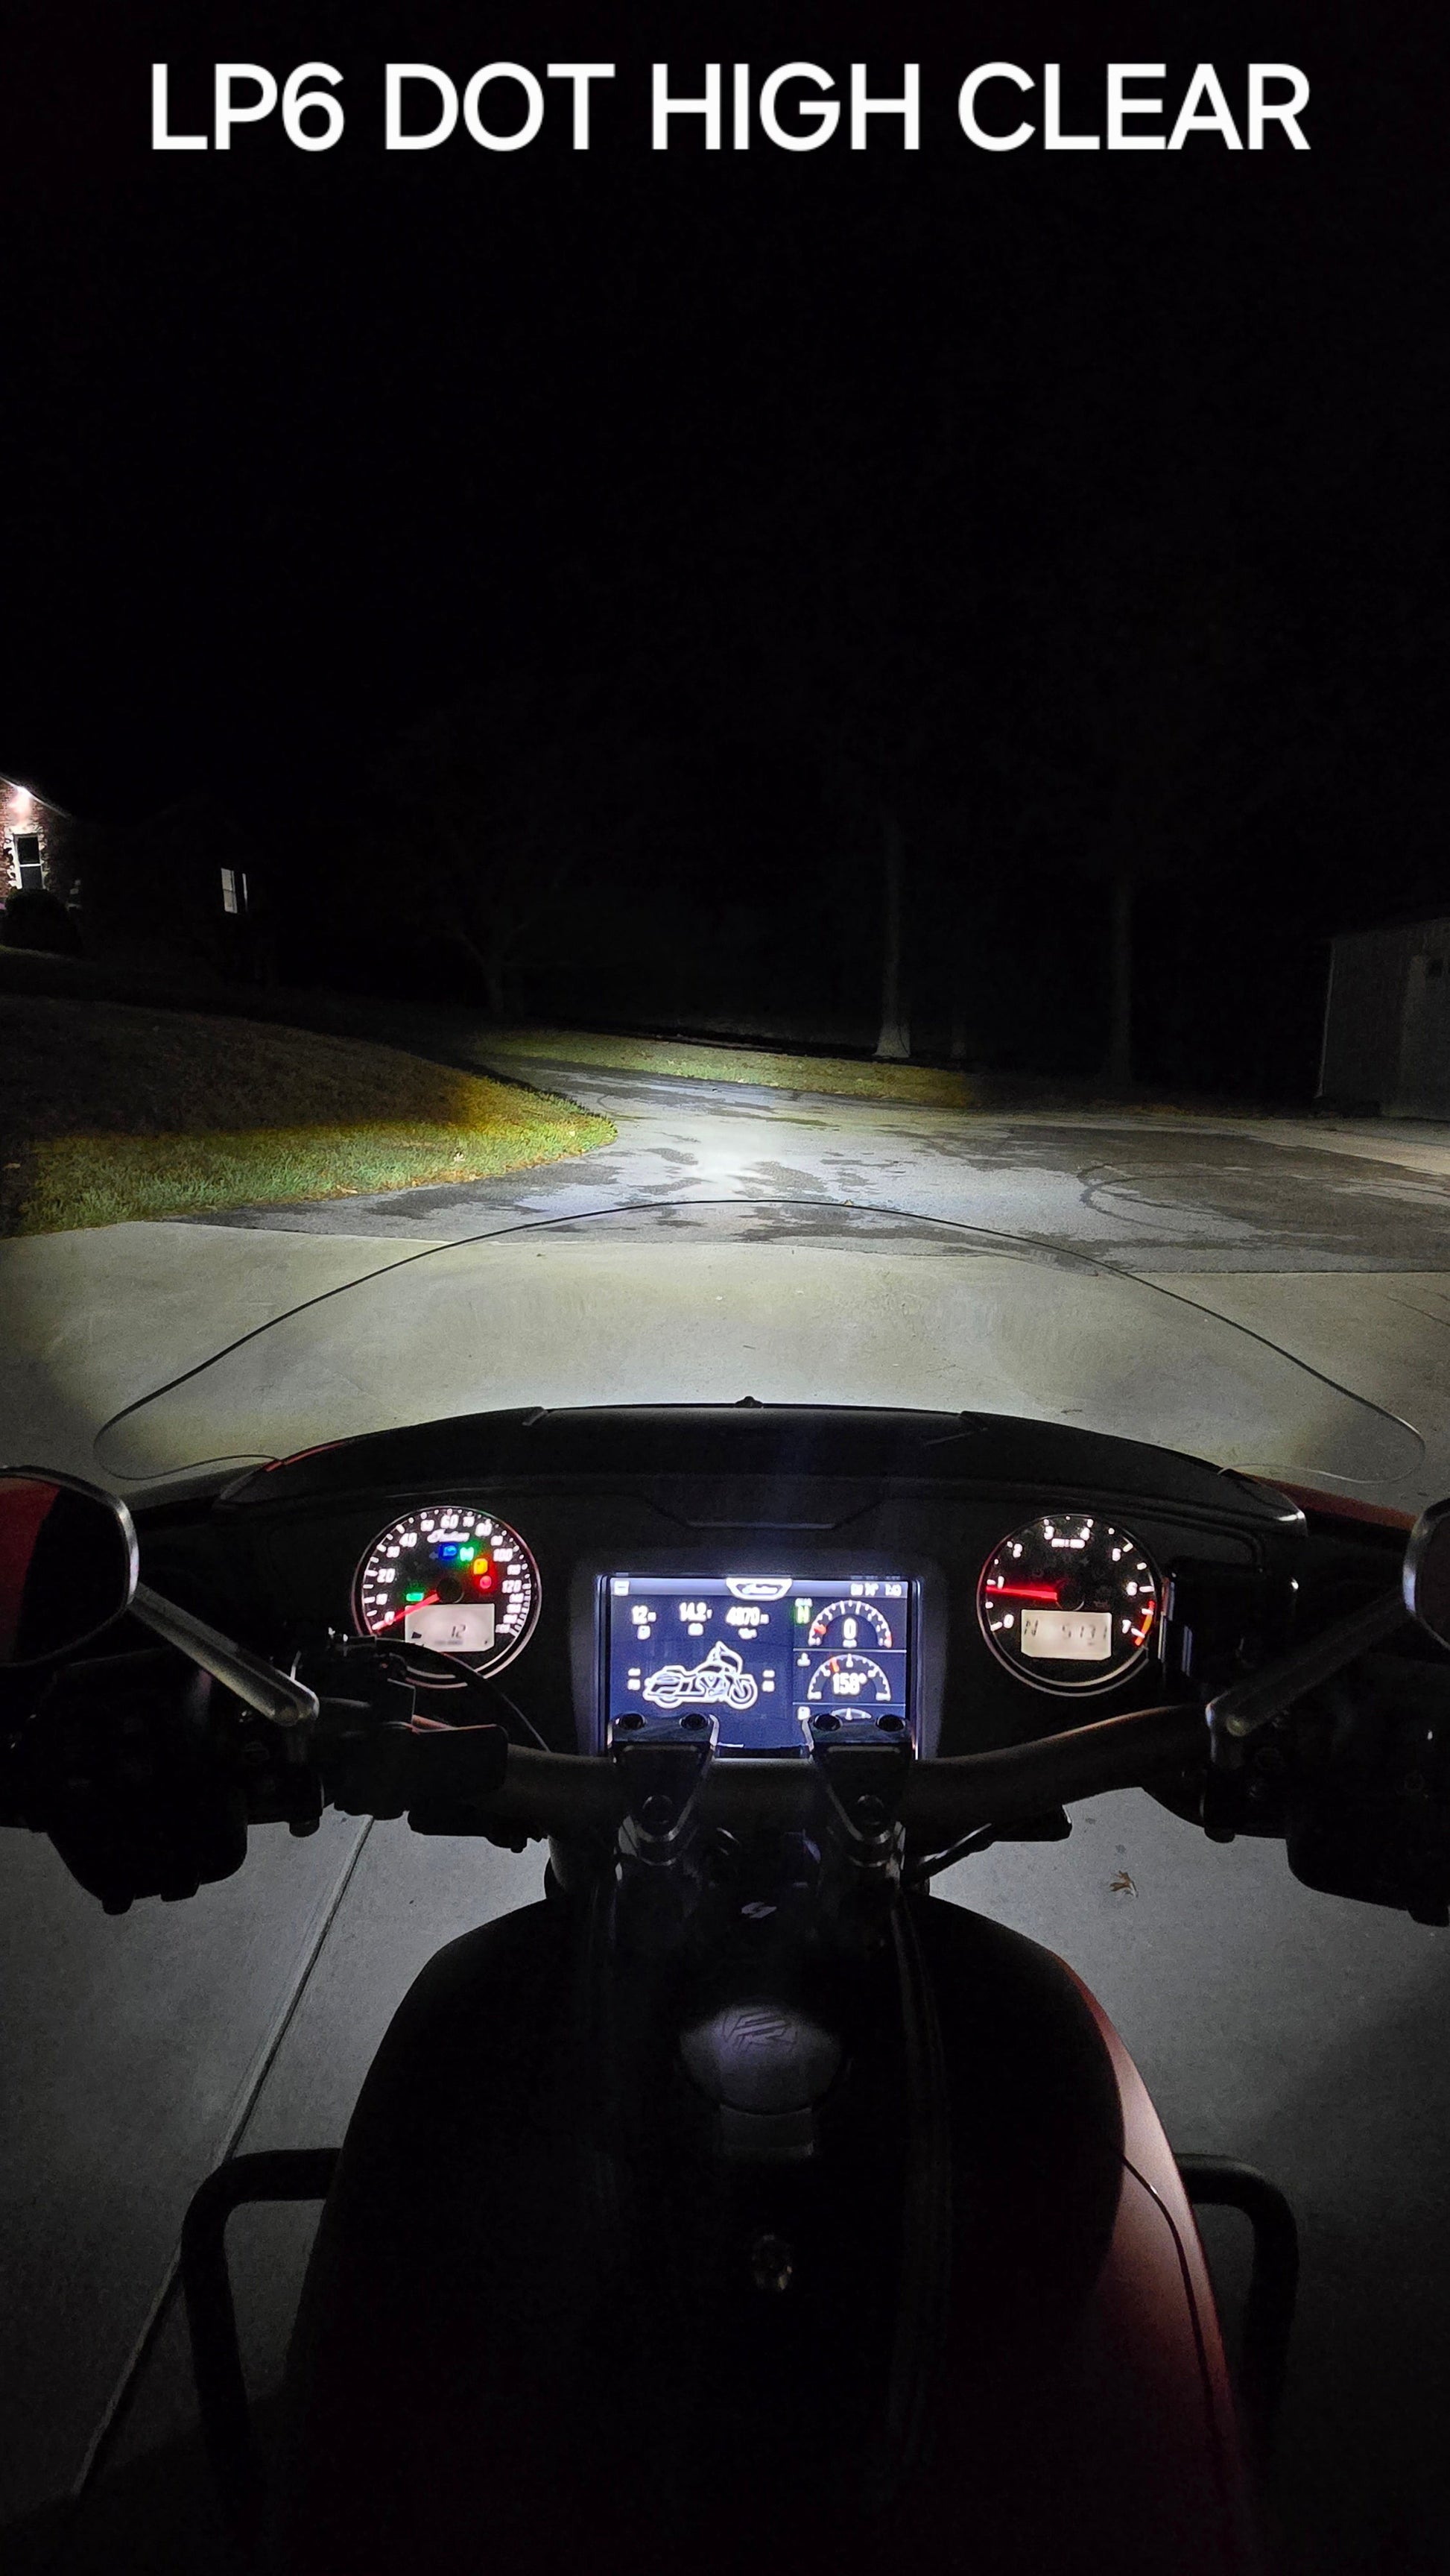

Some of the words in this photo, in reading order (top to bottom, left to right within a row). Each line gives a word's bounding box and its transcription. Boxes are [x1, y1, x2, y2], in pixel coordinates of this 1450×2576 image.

[440, 1515, 459, 1529] 60
[399, 1532, 417, 1547] 40
[1044, 1526, 1054, 1540] 3
[377, 1568, 395, 1582] 20
[502, 1579, 522, 1594] 120
[1127, 1582, 1137, 1596] 6
[843, 1617, 856, 1640] 0
[1004, 1614, 1014, 1629] 0
[1121, 1619, 1131, 1633] 7
[452, 1625, 467, 1639] 12
